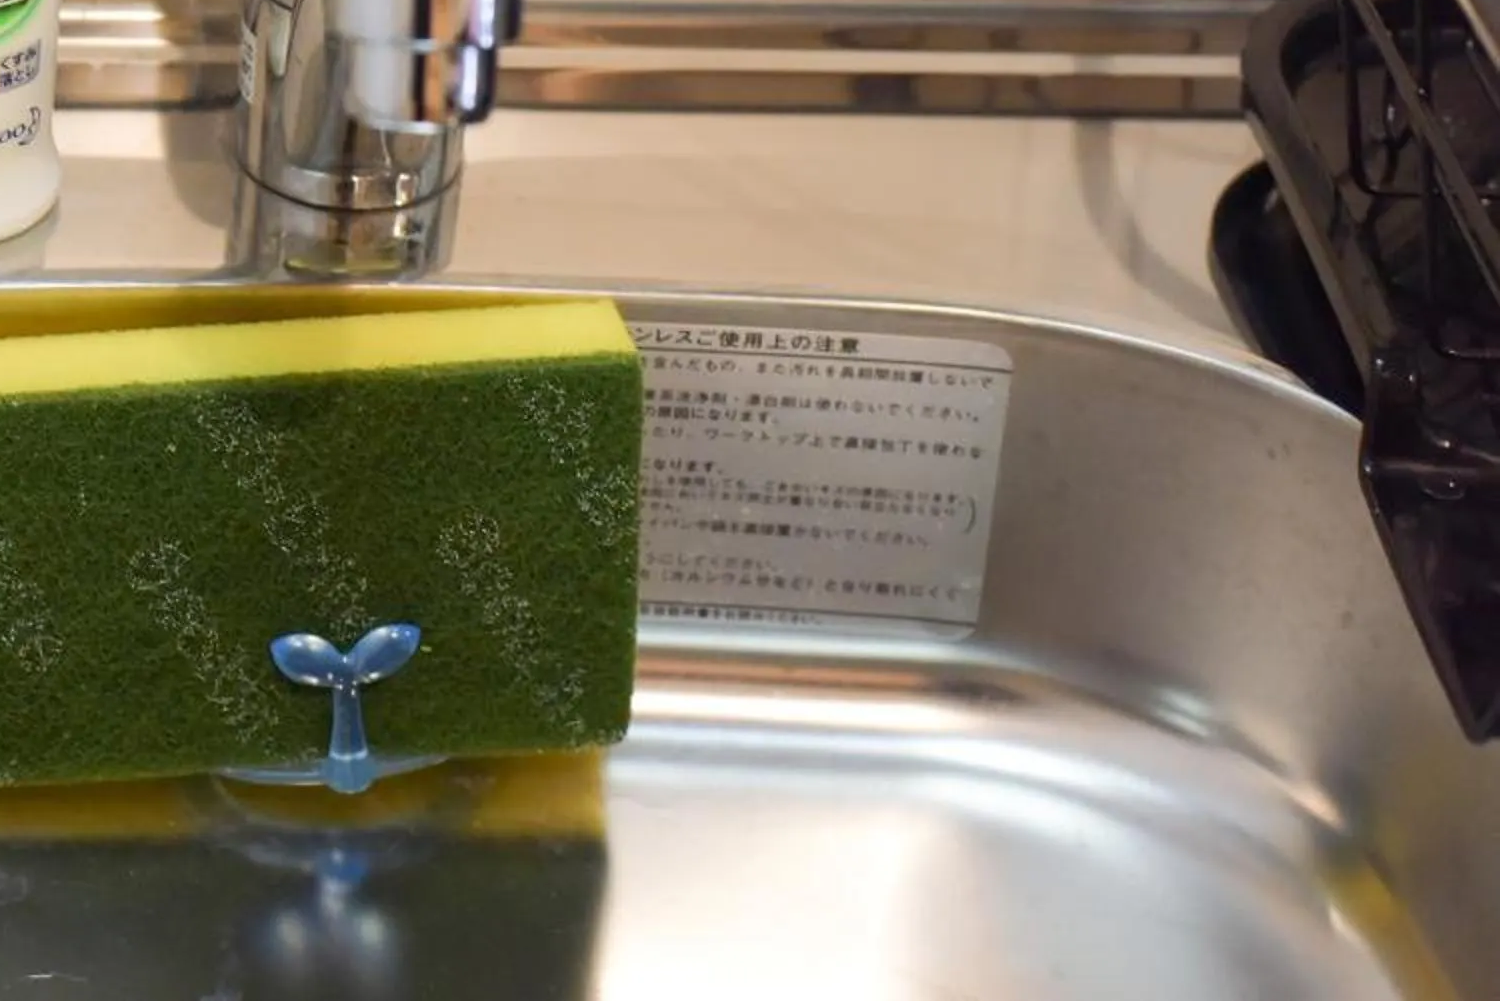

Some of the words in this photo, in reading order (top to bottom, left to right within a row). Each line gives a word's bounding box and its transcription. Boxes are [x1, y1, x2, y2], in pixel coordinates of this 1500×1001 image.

[629, 326, 859, 353] ンレスご使用上の注意
